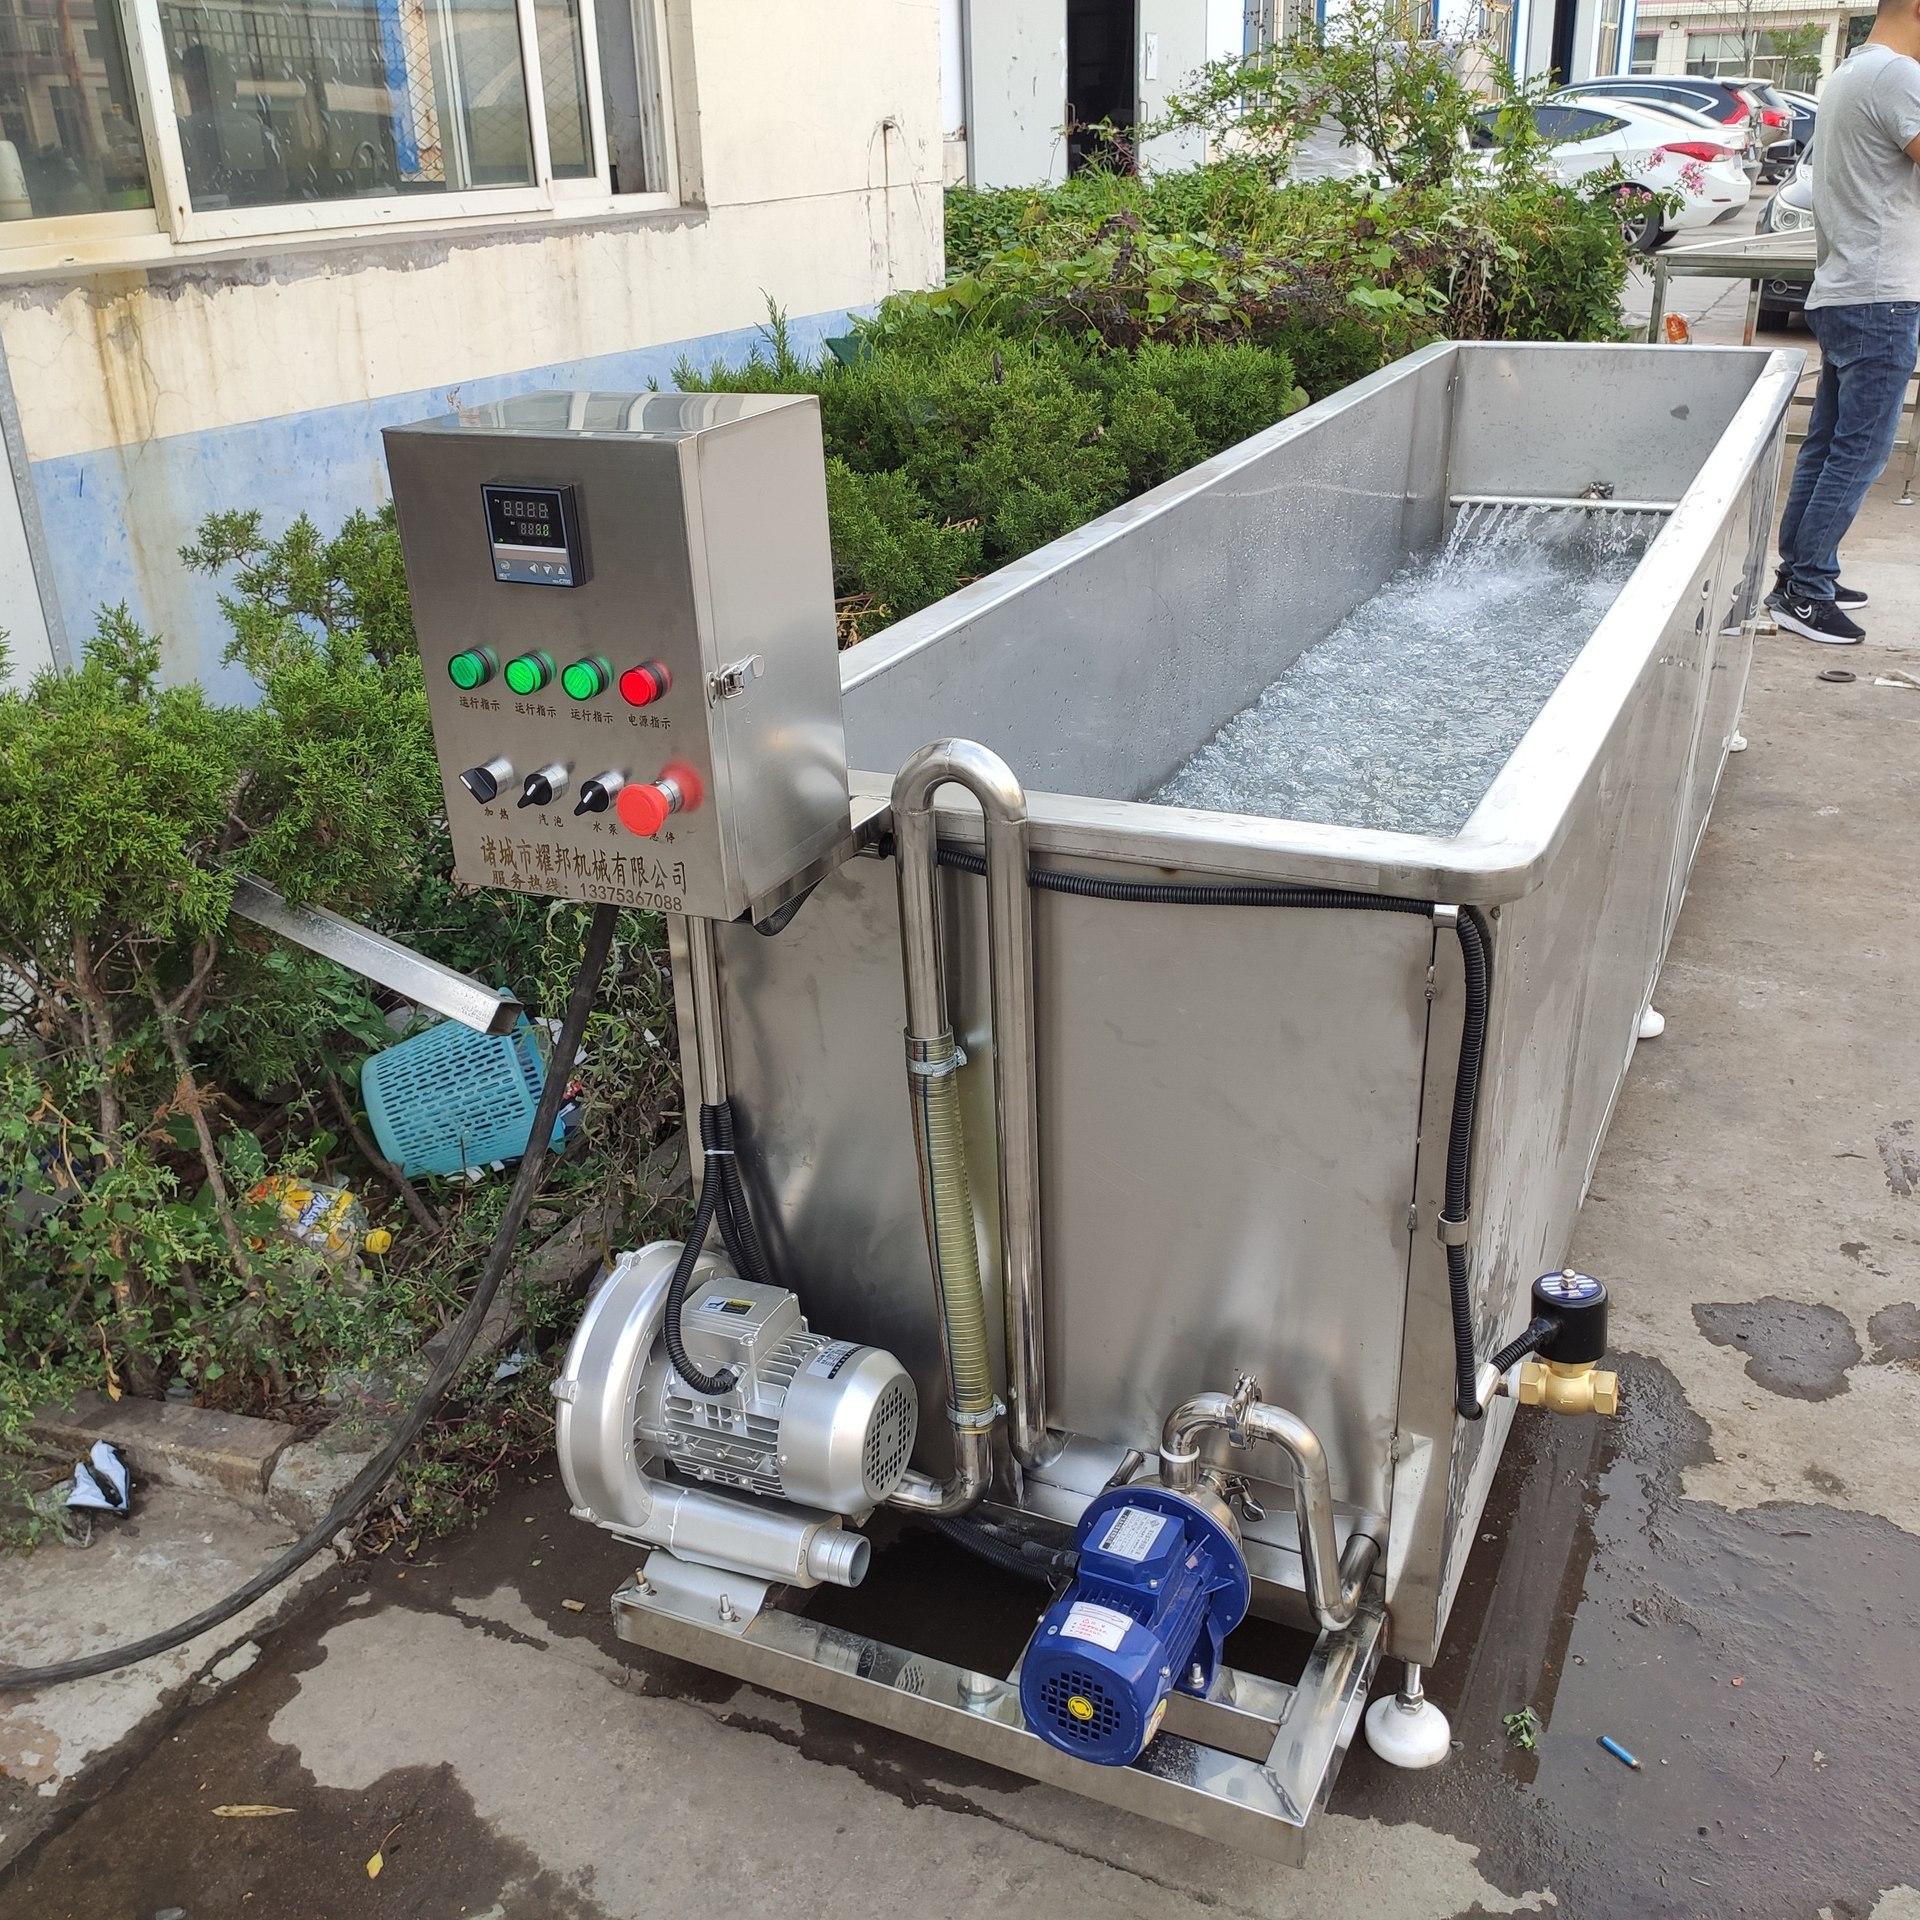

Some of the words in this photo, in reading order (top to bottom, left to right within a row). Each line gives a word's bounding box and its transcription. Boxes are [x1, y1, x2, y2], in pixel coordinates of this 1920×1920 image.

[459, 696, 500, 711] 运行指示
[515, 702, 557, 718] 运行指示
[570, 708, 614, 724] 运行指示
[628, 714, 671, 730] 电源指示
[480, 834, 687, 896] 诸城市耀邦机械有限公司
[580, 882, 683, 912] 13375367088
